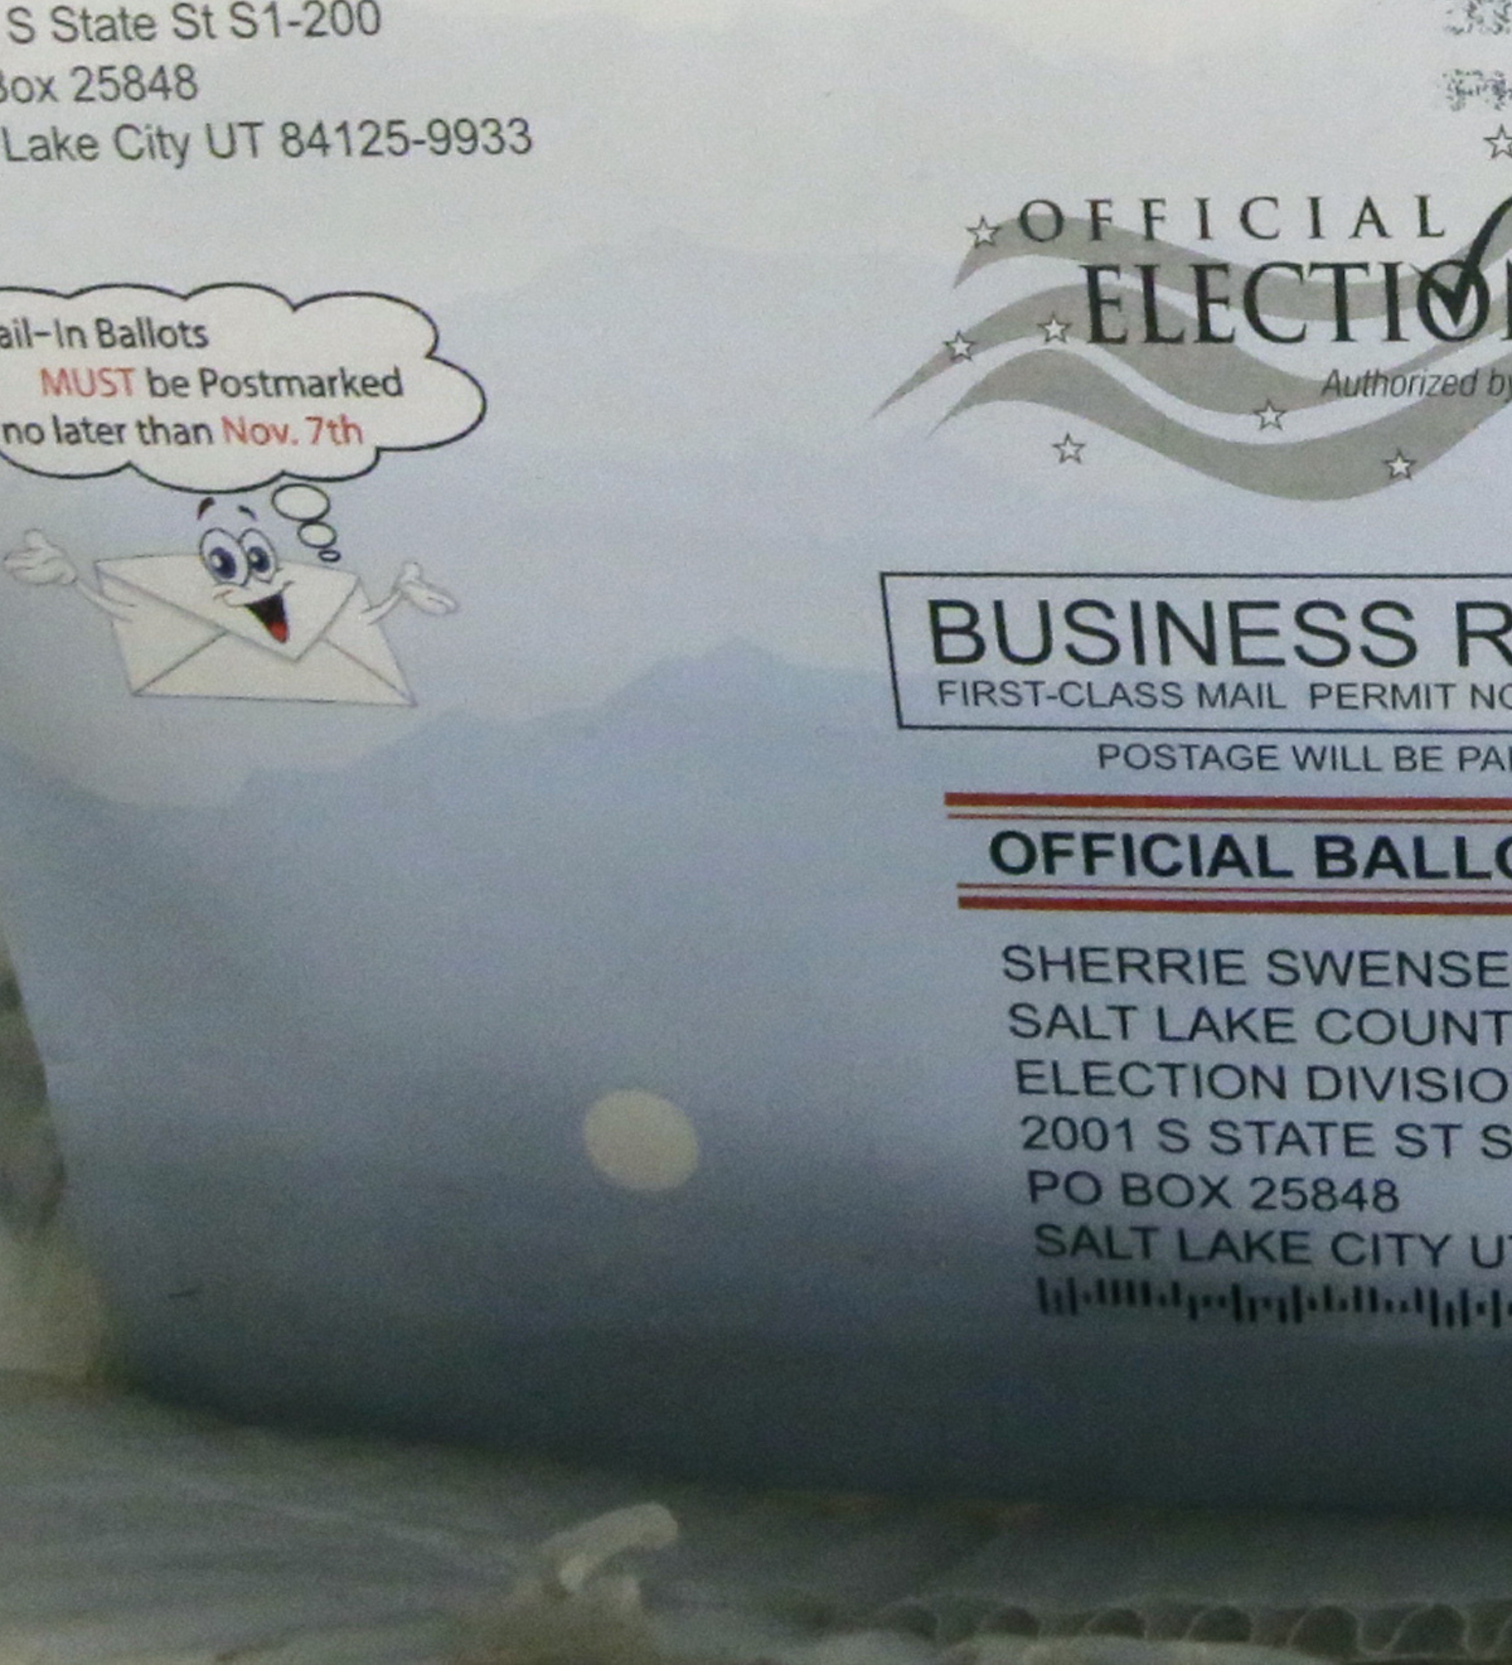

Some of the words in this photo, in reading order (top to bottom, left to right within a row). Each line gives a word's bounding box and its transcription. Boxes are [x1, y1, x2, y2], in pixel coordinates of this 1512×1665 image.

[6, 5, 36, 45] S
[49, 4, 157, 44] State
[171, 1, 218, 41] St
[70, 62, 199, 103] 25848
[0, 125, 100, 163] Lake
[112, 122, 191, 170] City
[205, 120, 265, 160] UT
[280, 116, 533, 159] 84125-9933
[1016, 194, 1447, 242] OFFICIAL
[94, 316, 210, 350] Ballots
[40, 367, 137, 400] MUST
[145, 366, 191, 399] be
[197, 365, 404, 399] Postmarked
[1320, 366, 1479, 397] Authorized
[1, 416, 46, 447] no
[51, 414, 127, 447] later
[135, 414, 214, 447] than
[220, 415, 299, 447] Nov.
[305, 415, 364, 446] 7th
[927, 598, 1418, 669] BUSINESS
[937, 679, 1185, 710] FIRST-CLASS
[1196, 681, 1287, 710] MAIL
[1309, 682, 1457, 711] PERMIT
[1097, 742, 1281, 772] POSTAGE
[1291, 744, 1383, 773] WILL
[1393, 744, 1444, 773] BE
[989, 829, 1294, 879] OFFICIAL
[1001, 943, 1247, 987] SHERRIE
[1008, 1002, 1139, 1041] SALT
[1156, 1005, 1297, 1045] LAKE
[1015, 1058, 1287, 1101] ELECTION
[1020, 1114, 1134, 1153] 2001
[1157, 1117, 1191, 1155] S
[1208, 1119, 1376, 1158] STATE
[1394, 1122, 1463, 1160] ST
[1027, 1169, 1104, 1207] PO
[1120, 1171, 1233, 1210] BOX
[1249, 1175, 1400, 1214] 25848
[1034, 1222, 1160, 1262] SALT
[1176, 1227, 1313, 1266] LAKE
[1330, 1231, 1452, 1269] CITY
